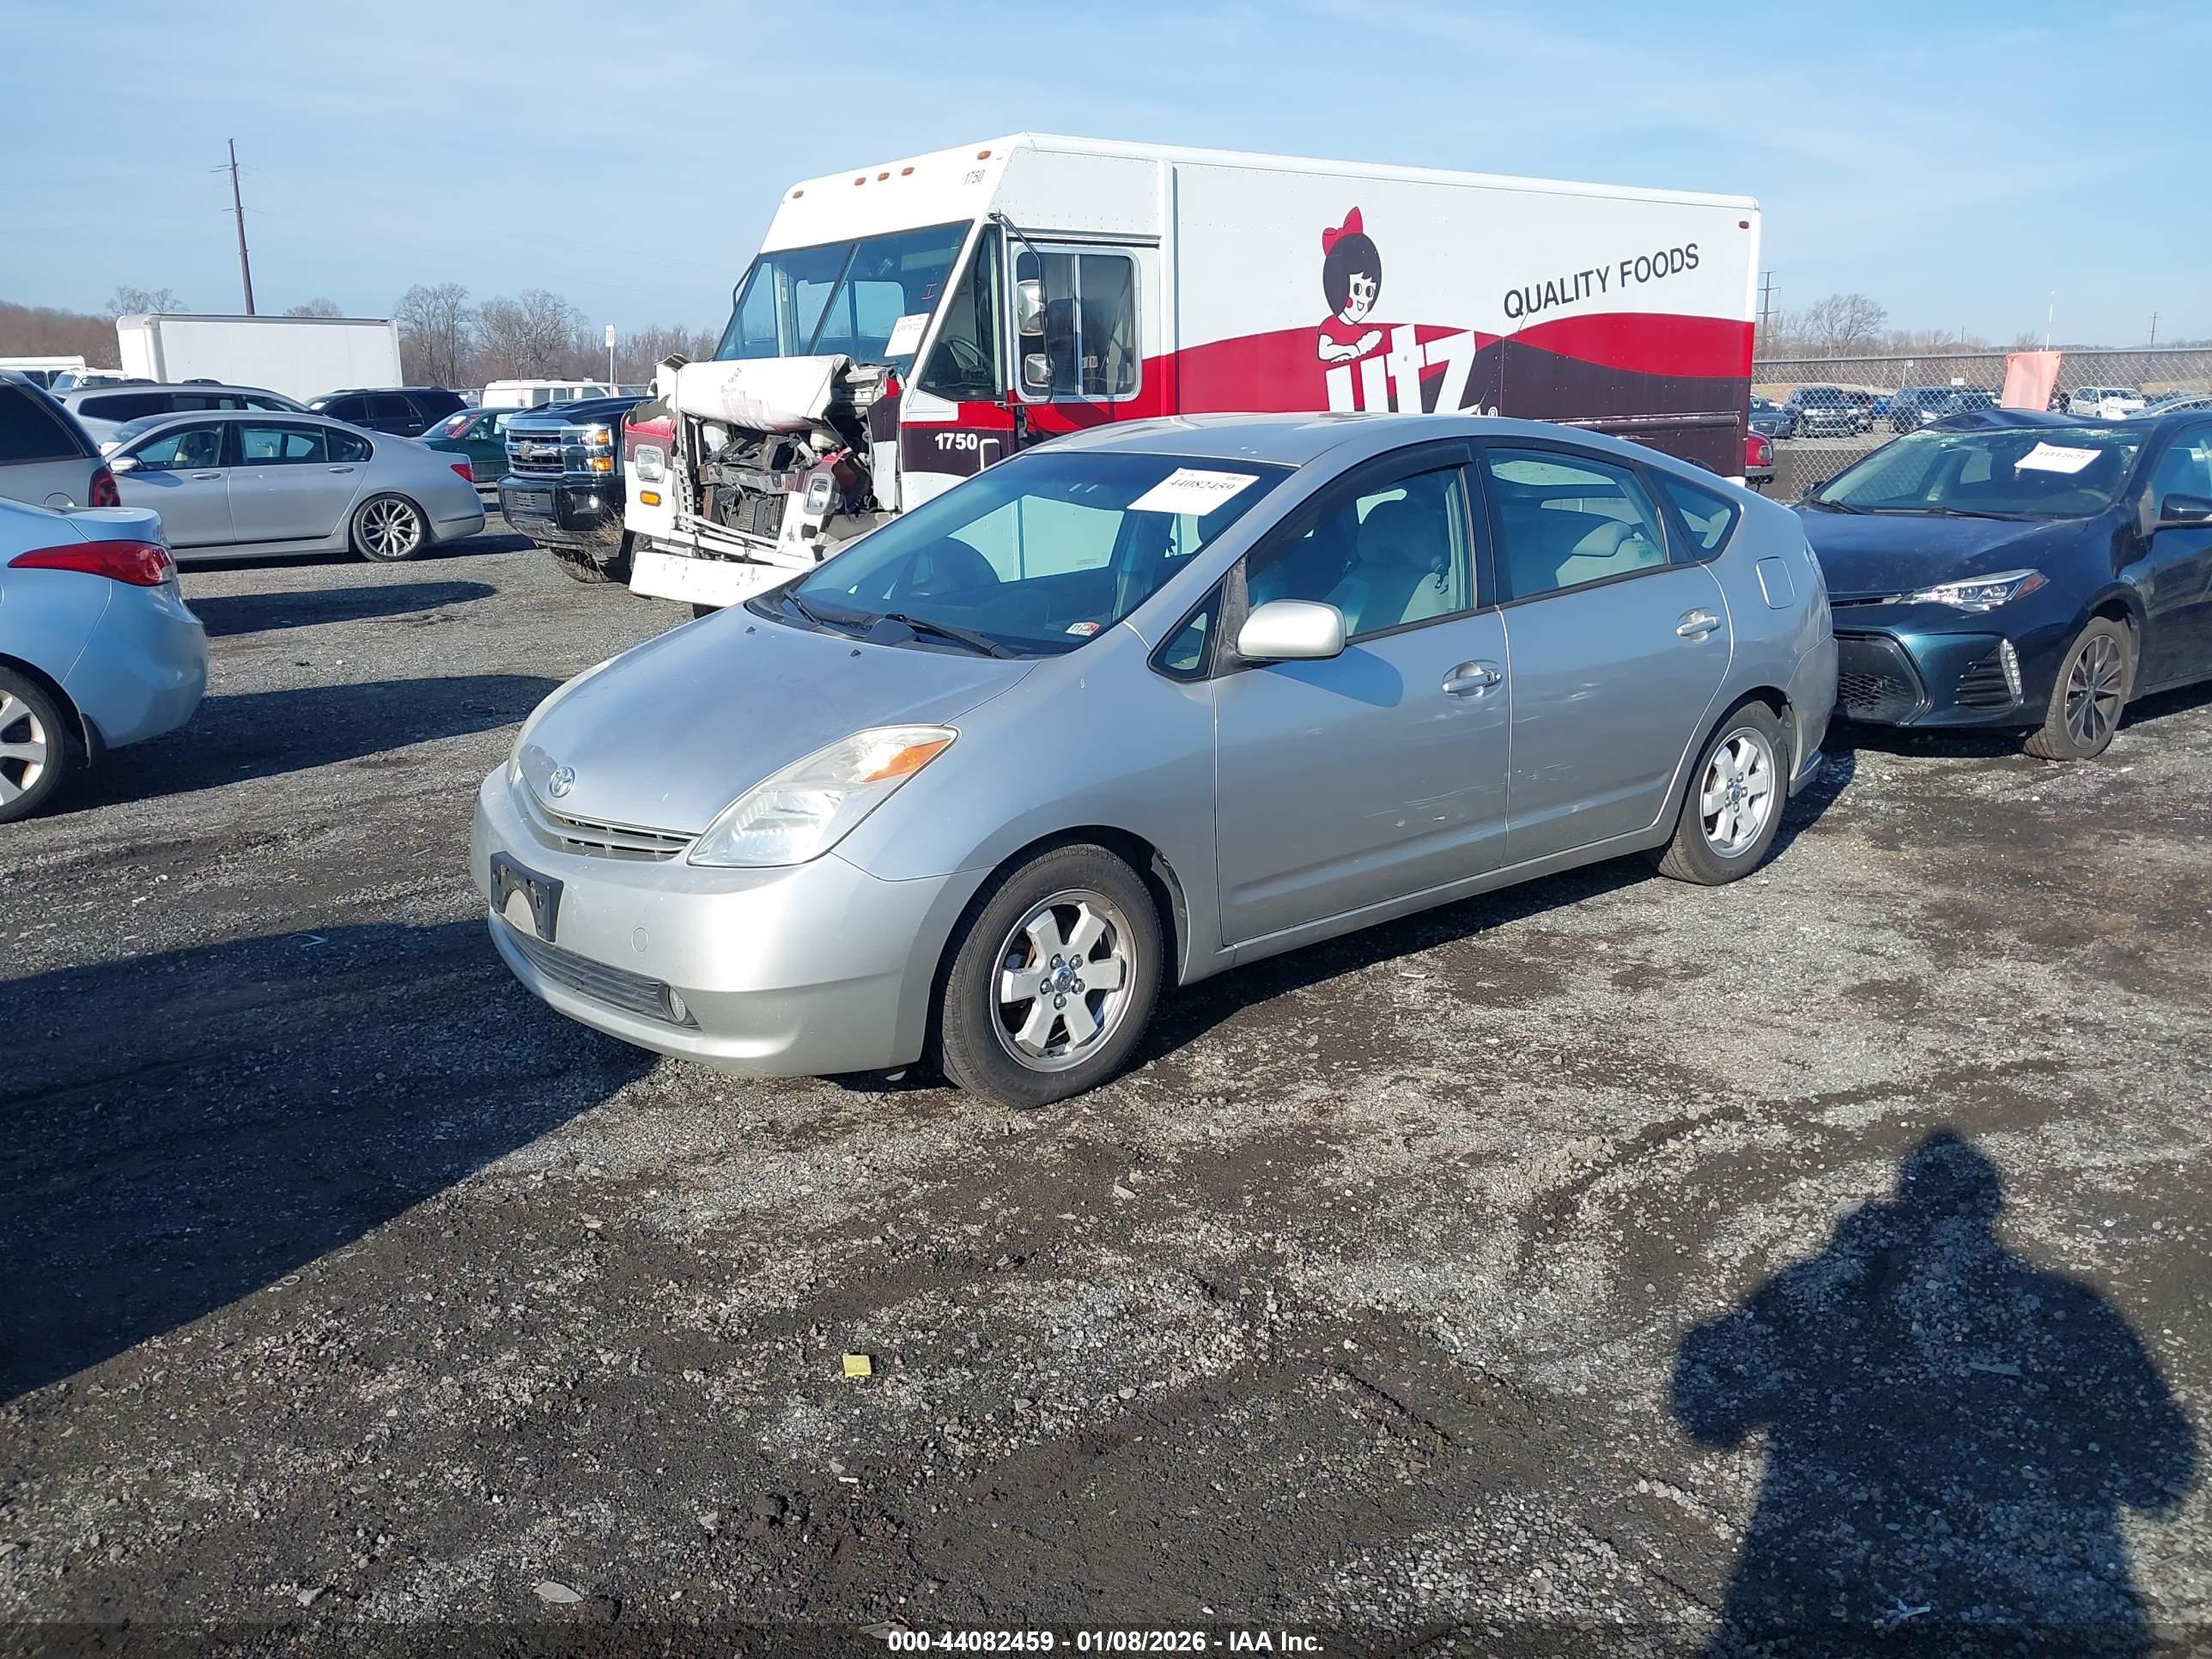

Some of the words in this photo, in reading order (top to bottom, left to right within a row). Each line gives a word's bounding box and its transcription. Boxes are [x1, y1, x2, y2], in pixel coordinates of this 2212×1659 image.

[963, 169, 985, 185] 1750
[1504, 265, 1610, 319] QUALITY
[1620, 243, 1699, 288] FOODS
[934, 433, 978, 450] 1750
[1170, 478, 1236, 491] 44082459
